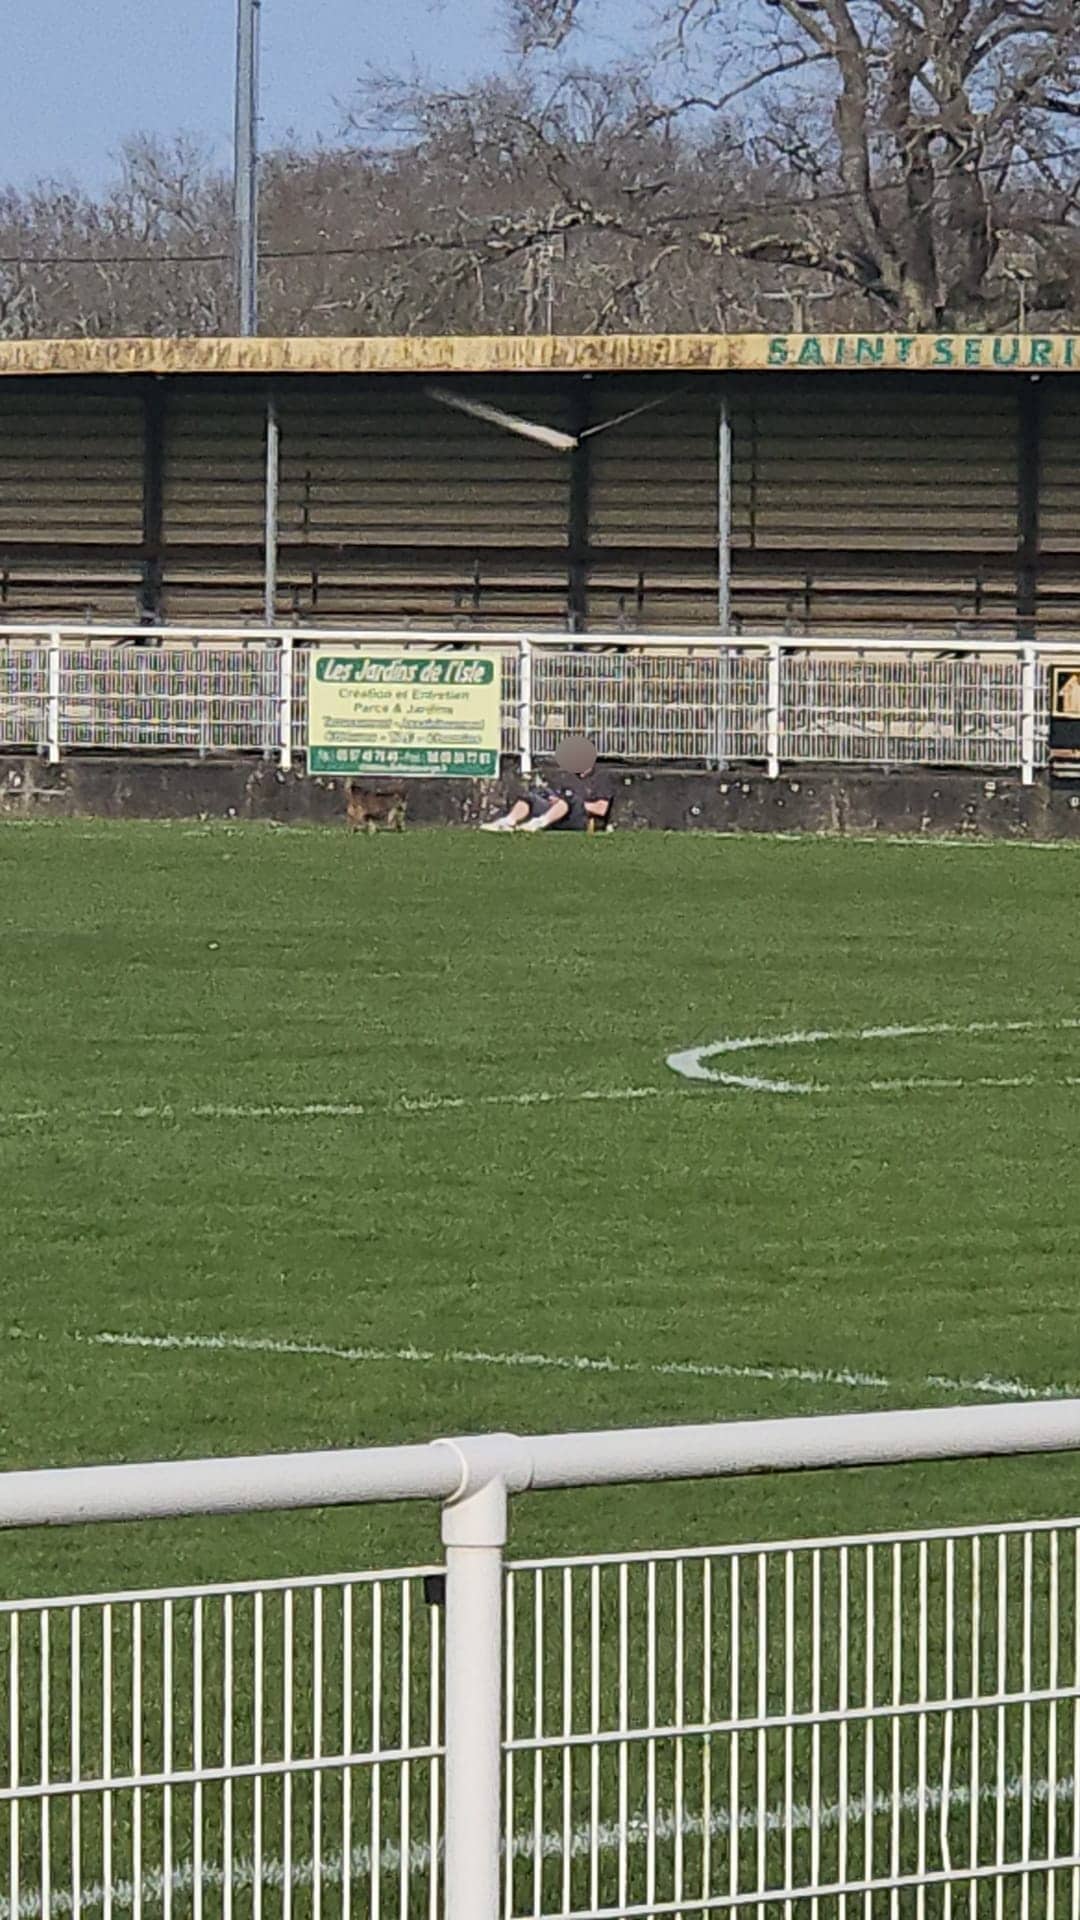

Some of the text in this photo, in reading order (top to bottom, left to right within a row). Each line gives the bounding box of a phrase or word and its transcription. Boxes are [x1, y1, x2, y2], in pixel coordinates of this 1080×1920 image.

[767, 337, 916, 366] SAINT
[323, 659, 486, 683] Les Jardins de l'Isle
[338, 688, 470, 701] Création et Entretien
[353, 703, 390, 714] Parcs
